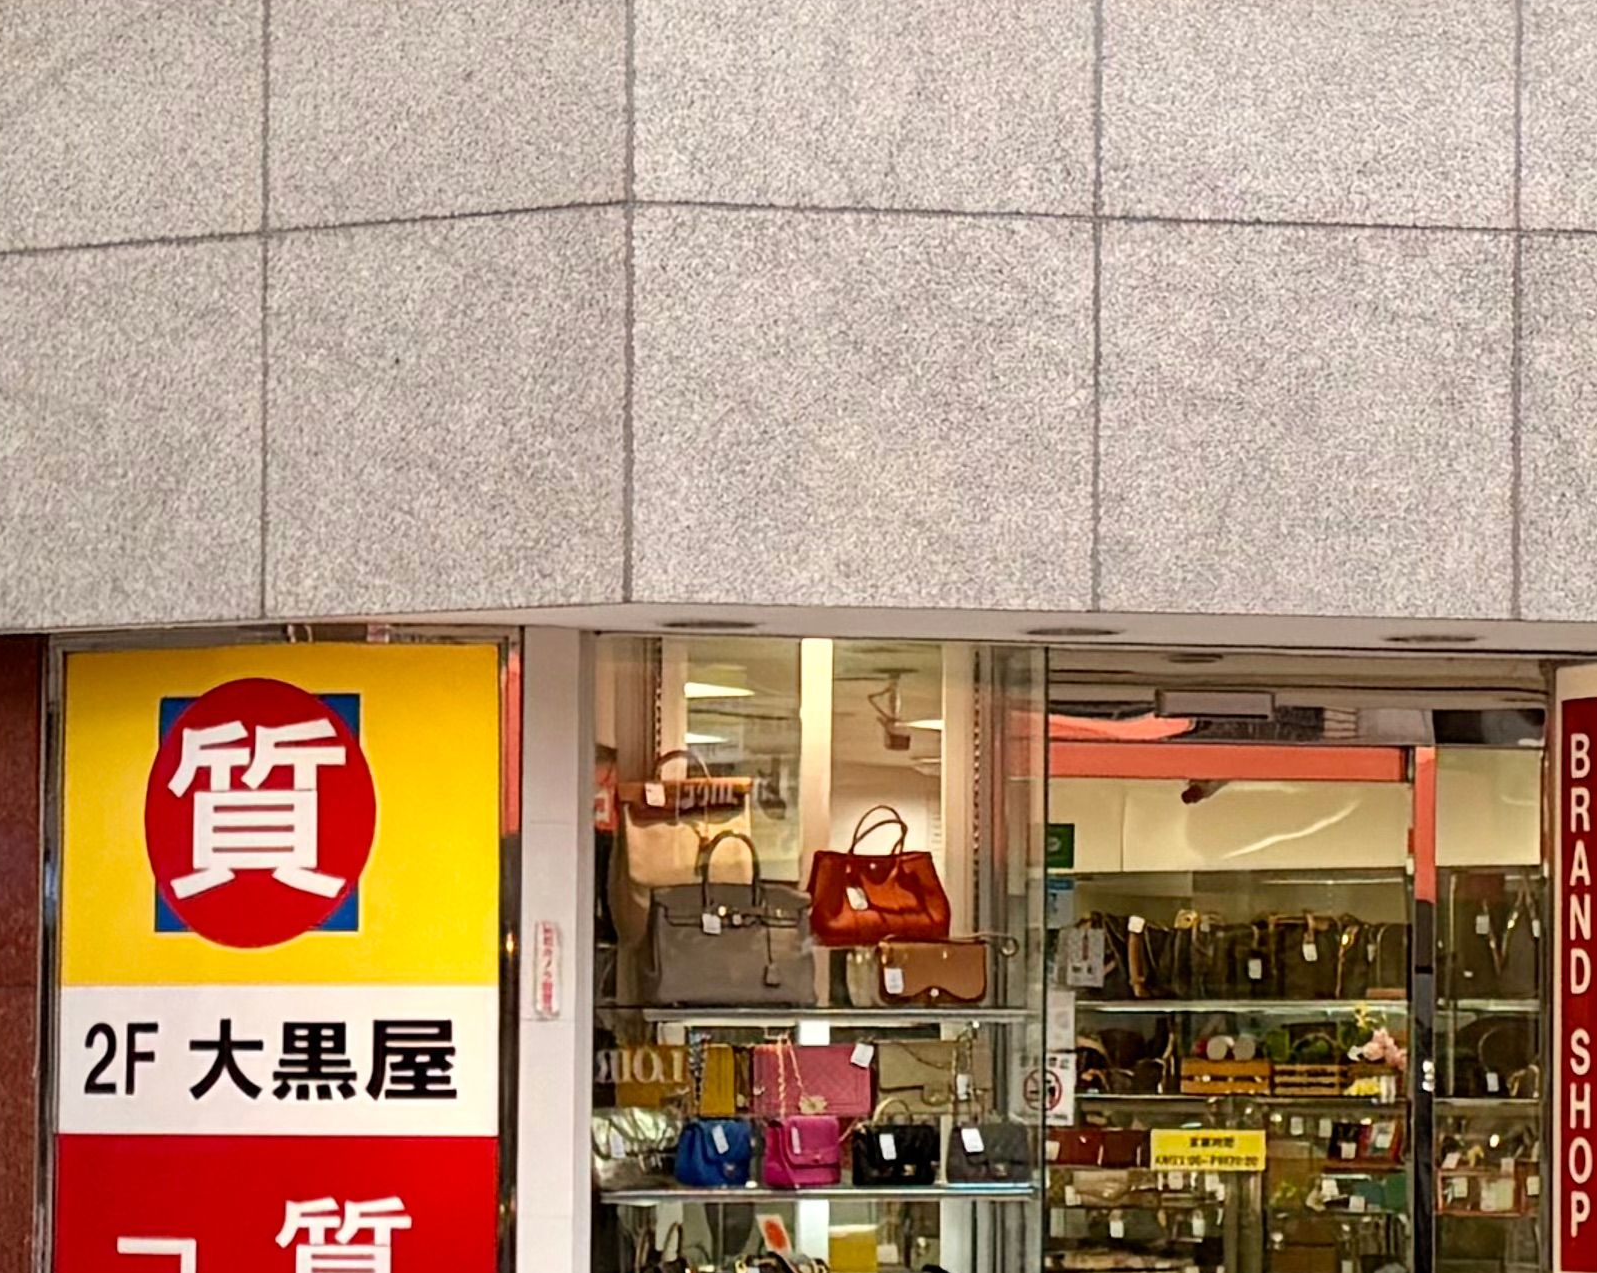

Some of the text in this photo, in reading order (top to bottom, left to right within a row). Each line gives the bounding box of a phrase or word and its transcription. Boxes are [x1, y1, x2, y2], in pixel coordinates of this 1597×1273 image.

[168, 718, 347, 900] 質
[1570, 733, 1591, 994] BRAND
[84, 1018, 458, 1101] 2F 大黒屋
[1568, 1028, 1593, 1238] SHOP
